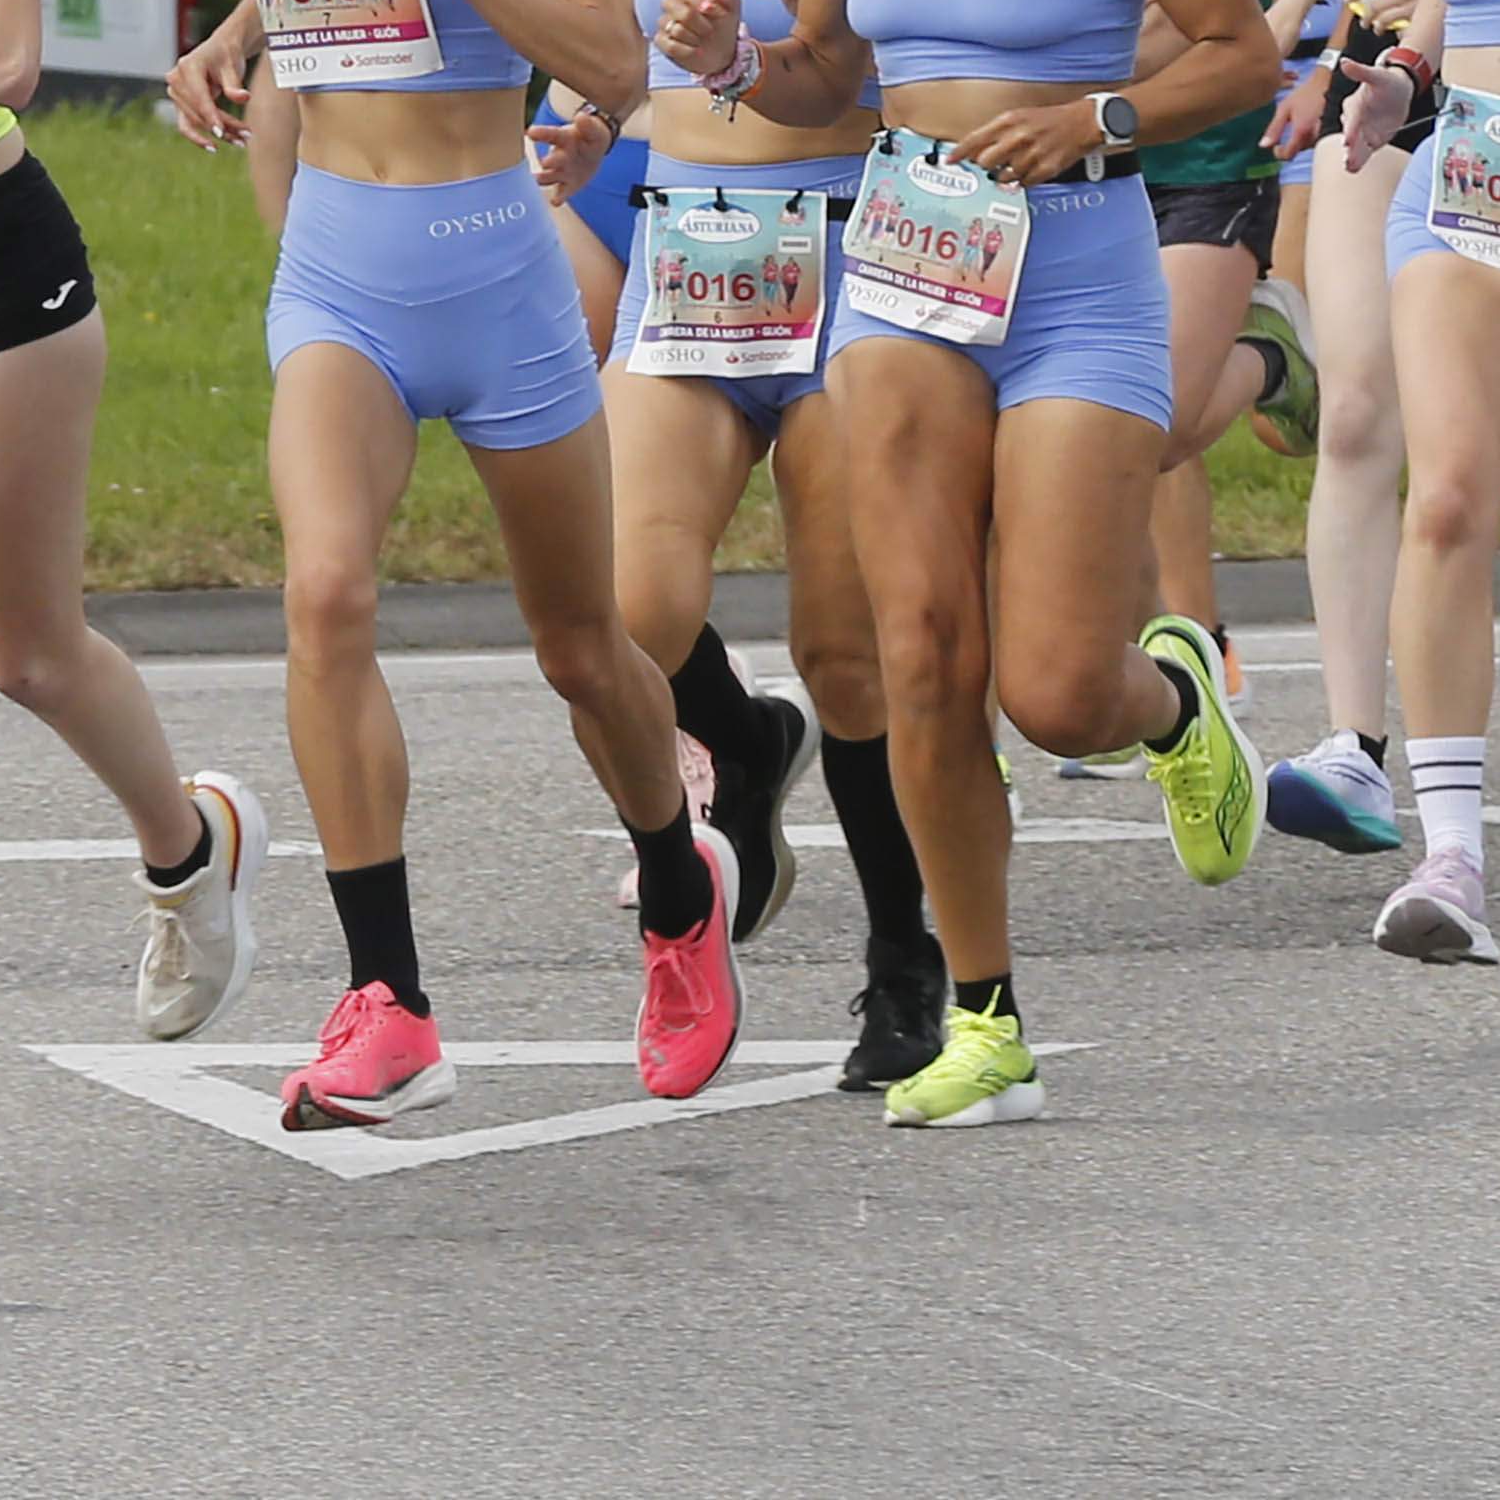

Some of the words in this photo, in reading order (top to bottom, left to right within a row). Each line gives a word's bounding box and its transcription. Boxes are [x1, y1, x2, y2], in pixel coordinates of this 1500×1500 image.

[277, 55, 318, 74] SHO
[910, 162, 974, 194] ASTURIANA
[428, 200, 526, 239] OYSHO
[1029, 190, 1106, 217] YSHO
[681, 215, 756, 235] ASTURIANA
[897, 217, 961, 262] 016
[686, 271, 757, 303] 016
